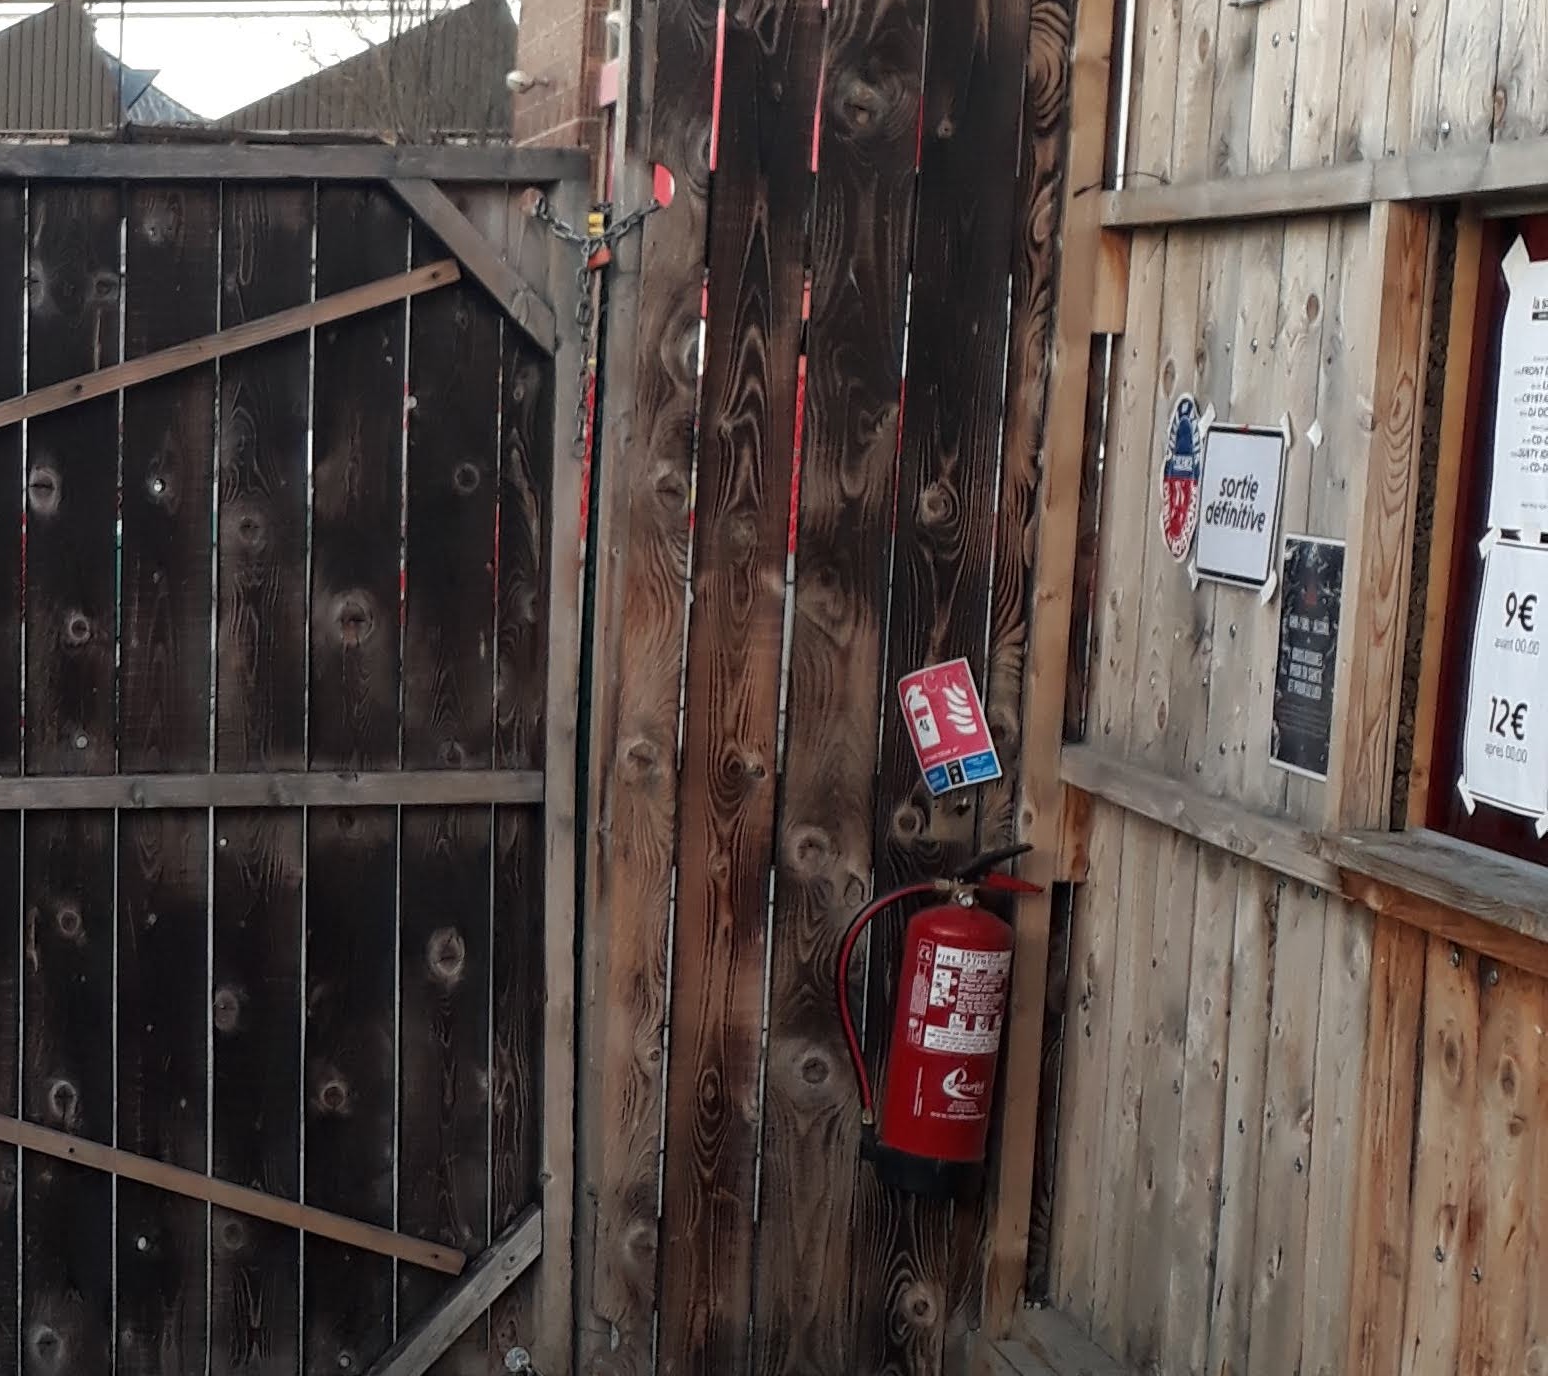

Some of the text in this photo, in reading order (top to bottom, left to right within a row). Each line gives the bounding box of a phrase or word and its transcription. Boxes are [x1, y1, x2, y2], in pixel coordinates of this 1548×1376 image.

[1219, 474, 1260, 501] sortie
[1205, 500, 1266, 533] définitive
[1505, 591, 1538, 632] 9€
[1489, 696, 1528, 741] 12€
